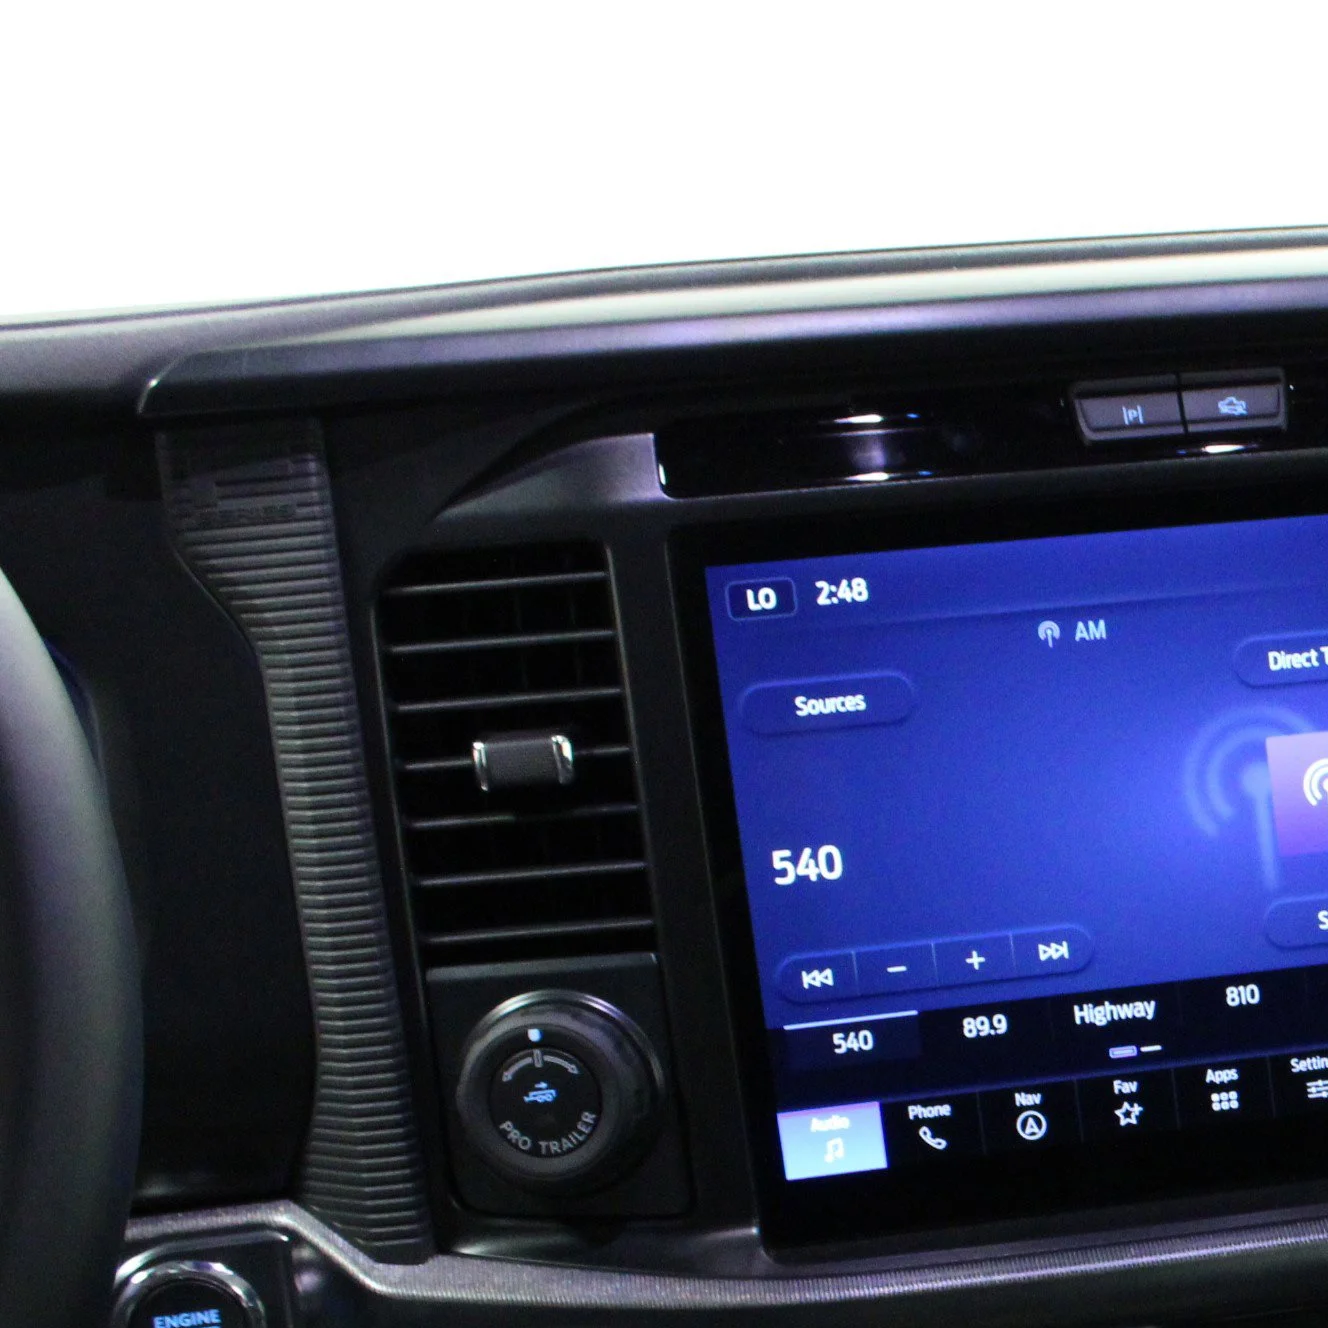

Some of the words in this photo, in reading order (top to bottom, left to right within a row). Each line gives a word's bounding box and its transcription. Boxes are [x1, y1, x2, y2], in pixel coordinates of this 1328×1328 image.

[745, 587, 777, 611] LO
[814, 577, 868, 605] 2:48
[1074, 618, 1107, 643] AM
[1268, 649, 1319, 672] Direct
[794, 694, 867, 716] Sources
[771, 843, 843, 886] 540
[1224, 983, 1262, 1008] 810
[1073, 998, 1157, 1026] Highway
[962, 1013, 1008, 1039] 89.9
[831, 1029, 874, 1054] 540
[1112, 1079, 1138, 1095] Fav
[1205, 1067, 1239, 1085] Apps
[908, 1102, 952, 1120] Phone
[1014, 1091, 1042, 1107] Nav
[499, 1121, 532, 1150] PRO
[539, 1111, 597, 1154] TRAILER
[809, 1115, 850, 1132] Audio
